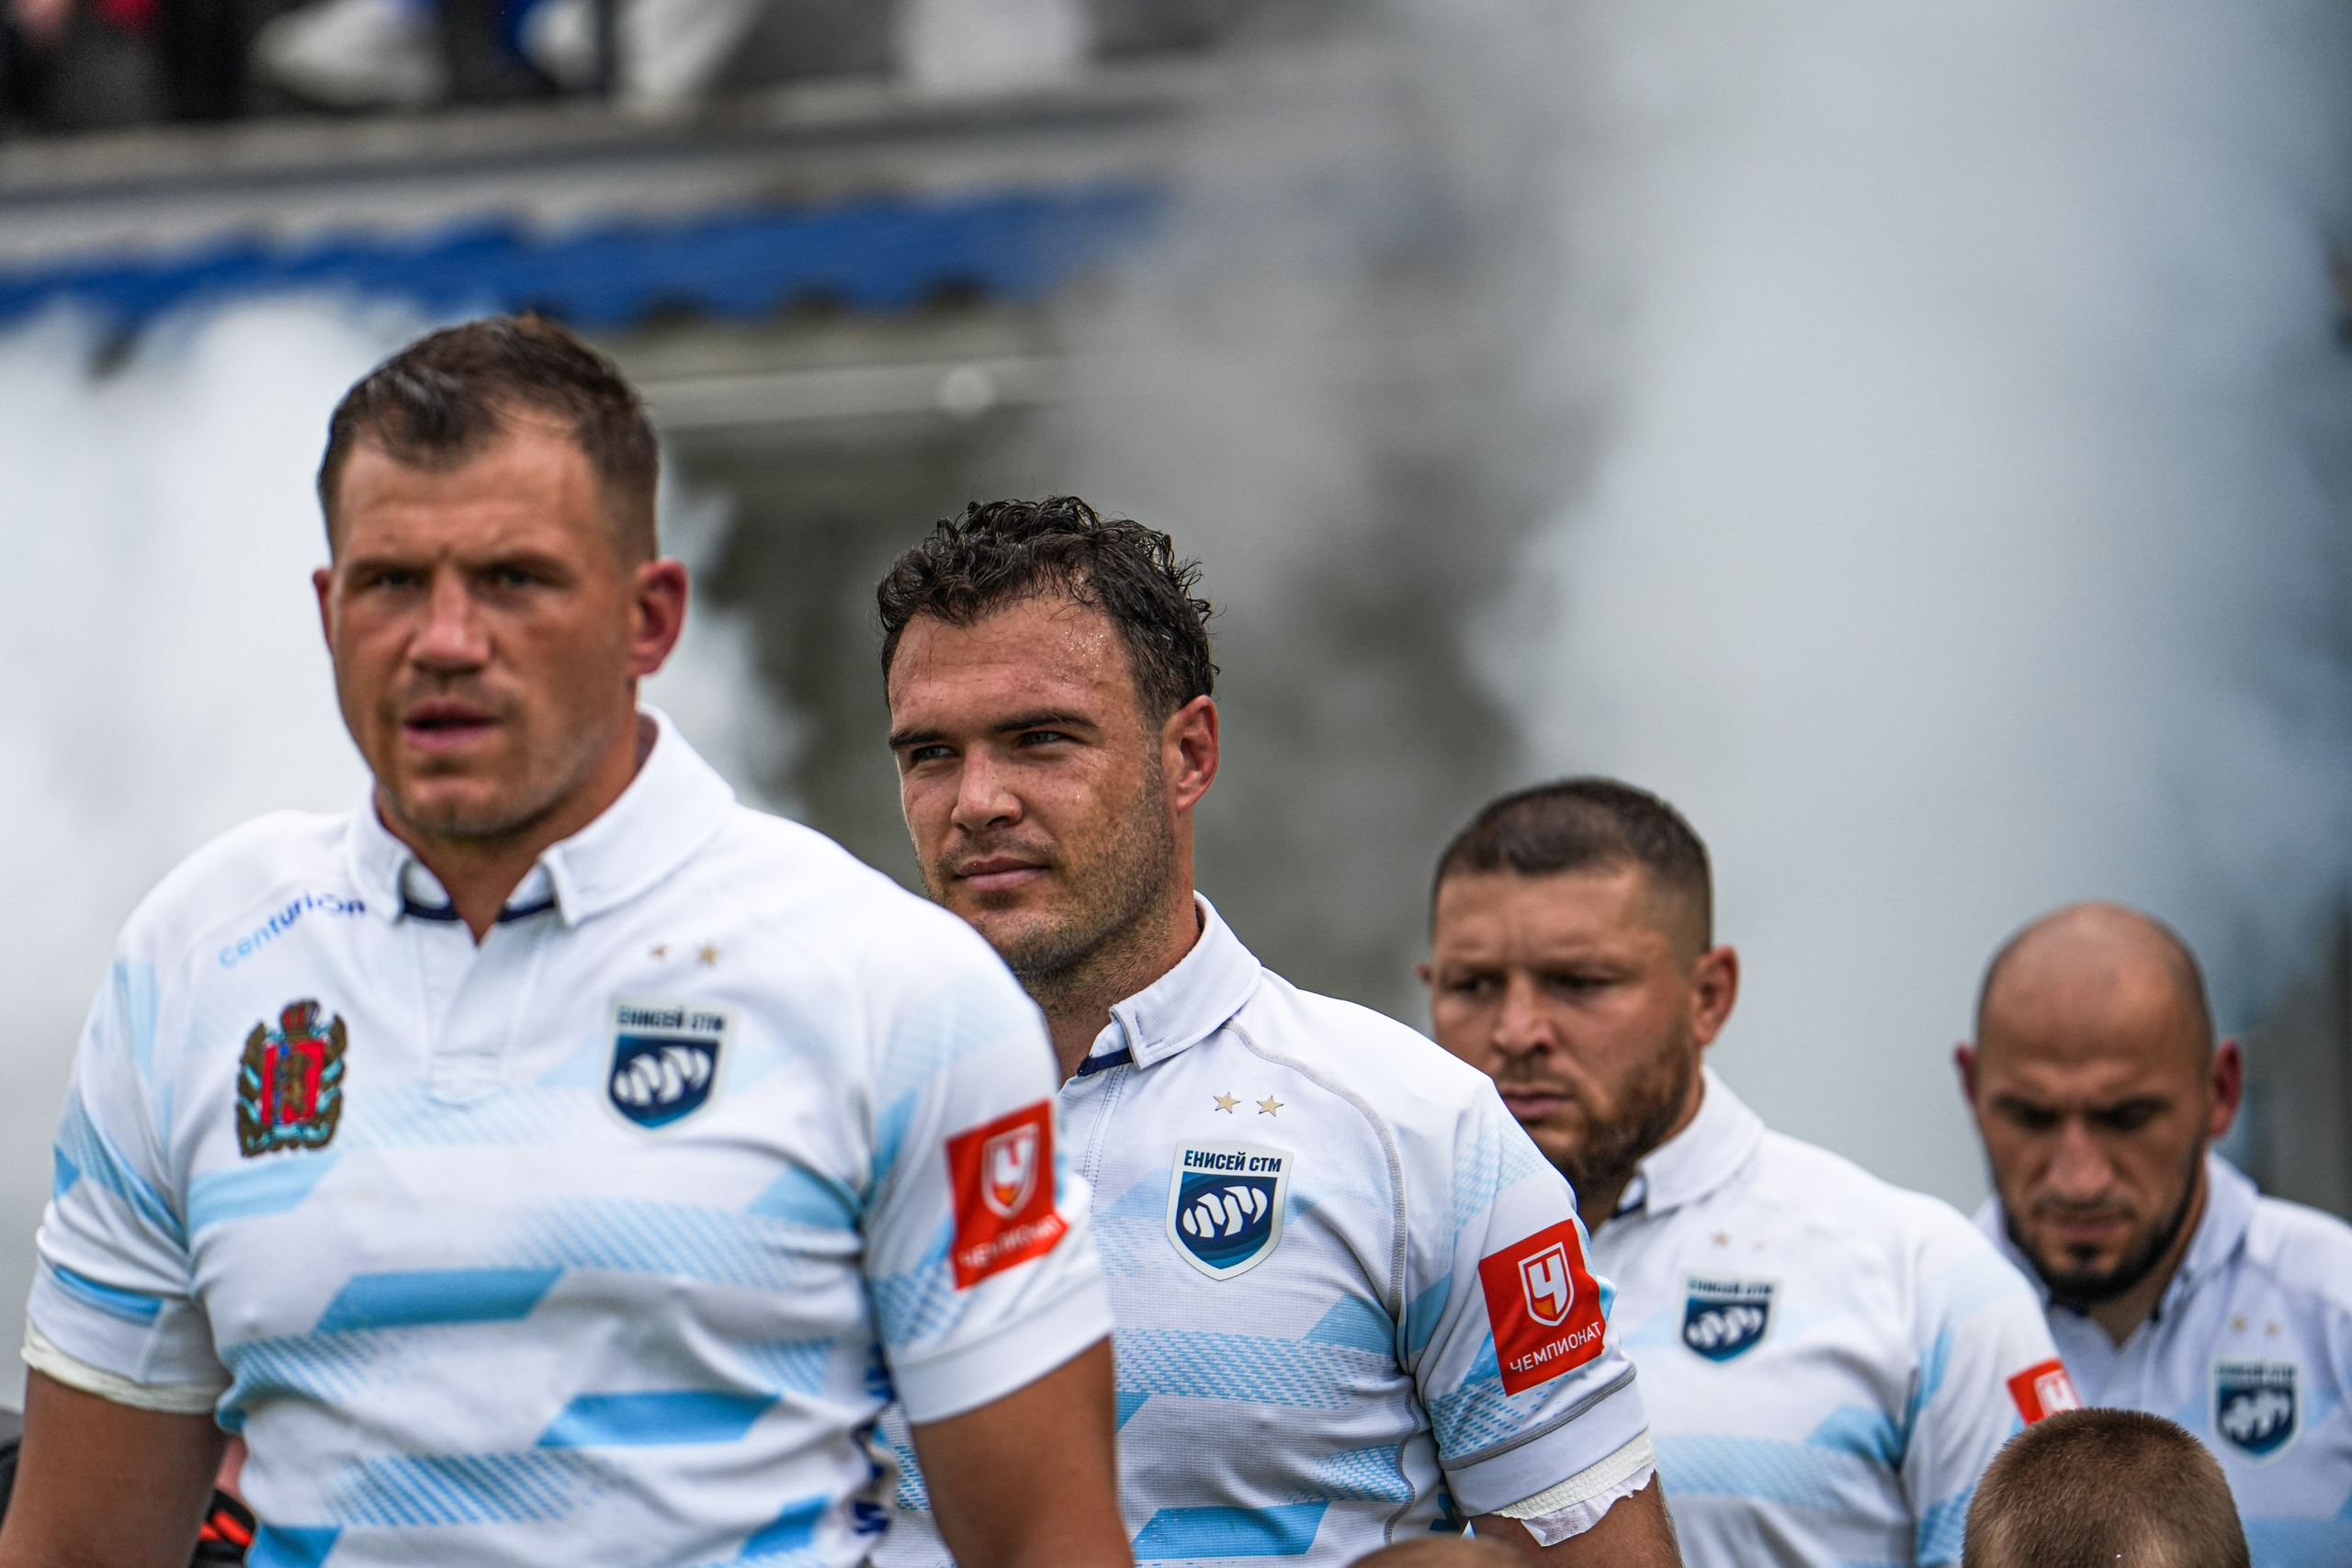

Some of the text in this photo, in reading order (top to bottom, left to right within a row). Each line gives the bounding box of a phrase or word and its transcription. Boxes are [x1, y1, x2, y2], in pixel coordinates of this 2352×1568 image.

[219, 889, 366, 968] centurion
[1183, 1149, 1283, 1173] ЕНИСЕЙ СТМ
[1527, 1252, 1568, 1314] Ч
[1510, 1321, 1601, 1373] ЧЕМПИОНАТ
